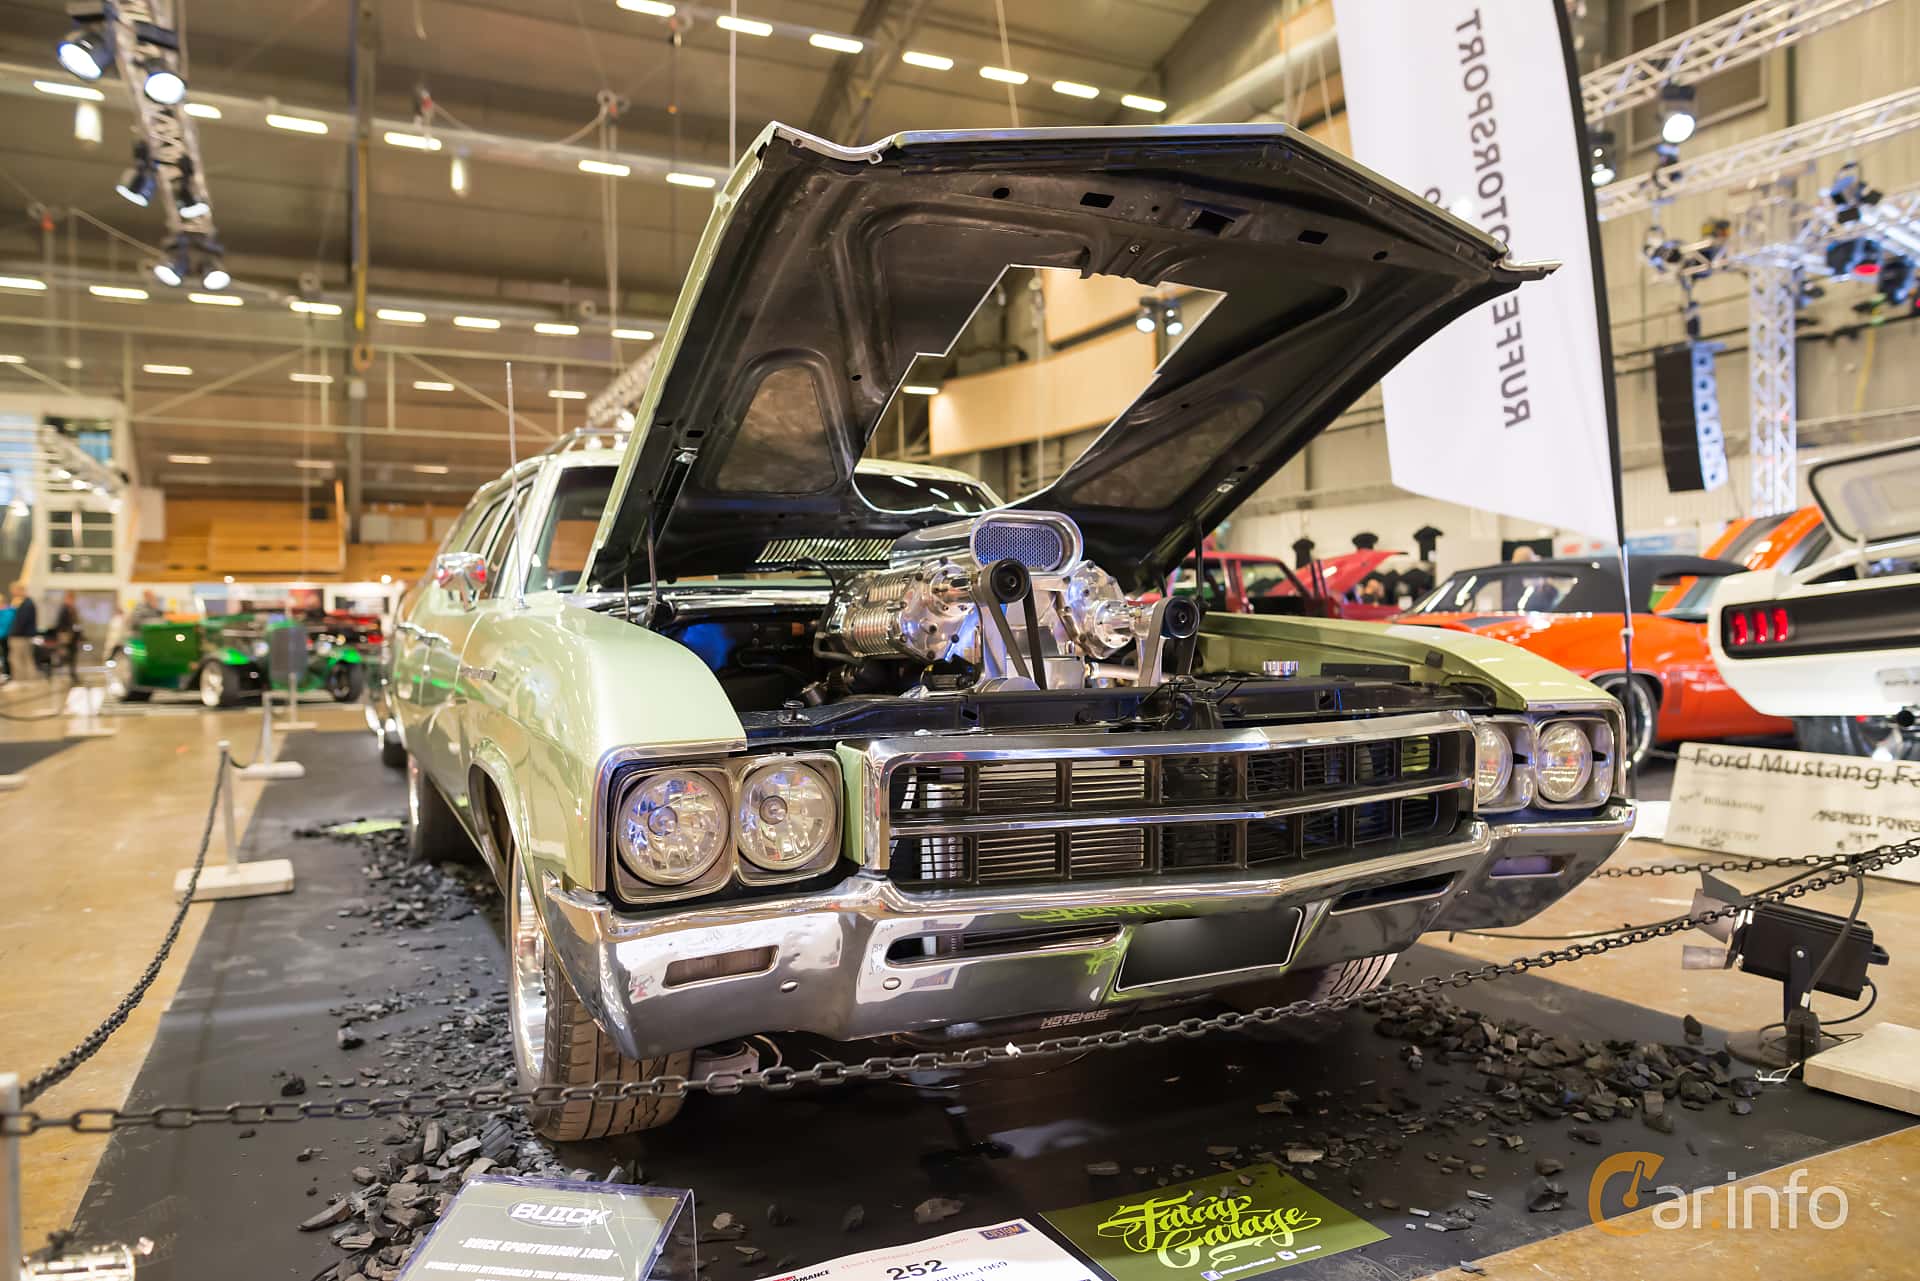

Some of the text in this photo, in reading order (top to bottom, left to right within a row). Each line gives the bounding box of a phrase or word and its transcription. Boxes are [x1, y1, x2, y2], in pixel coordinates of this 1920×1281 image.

[1693, 747, 1750, 770] Ford
[1759, 753, 1882, 789] Mustang
[510, 1203, 612, 1225] BUICK
[1156, 1207, 1322, 1269] Garage
[885, 1259, 947, 1281] 252
